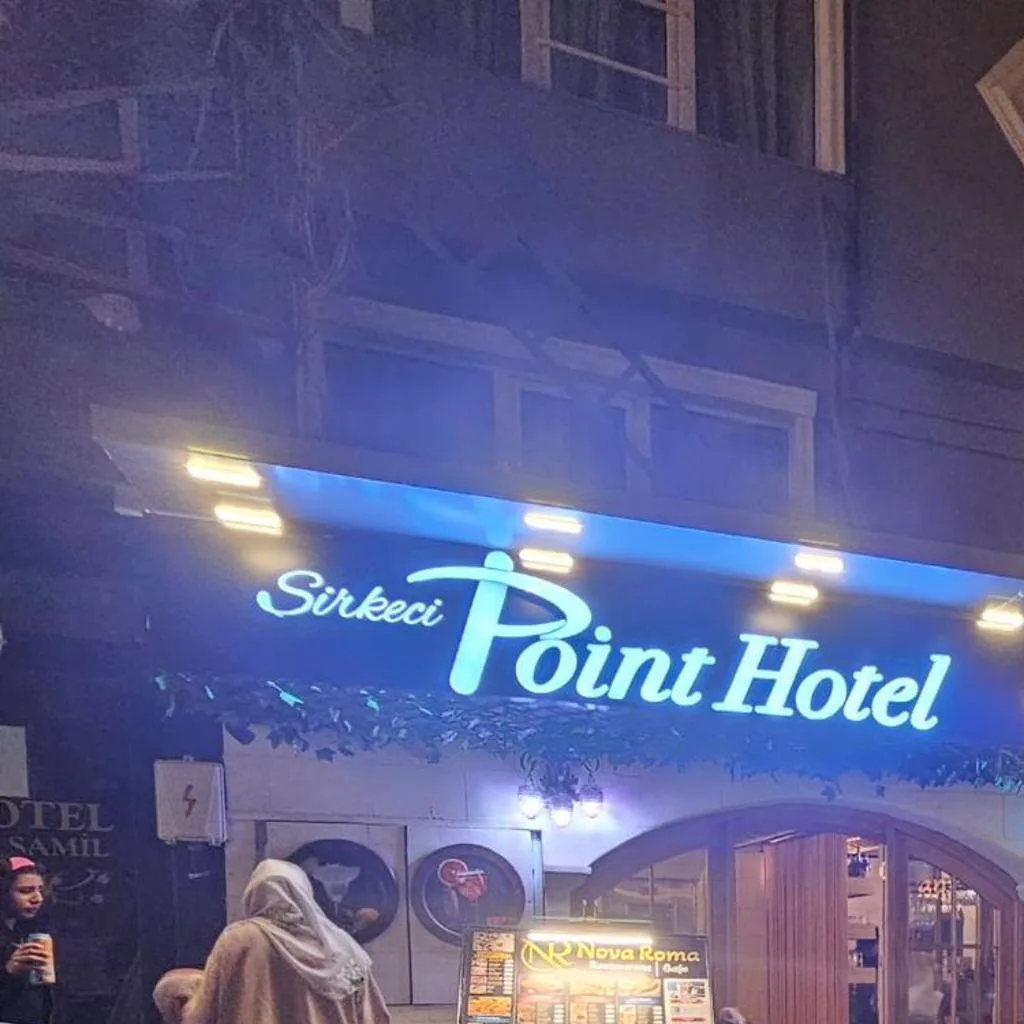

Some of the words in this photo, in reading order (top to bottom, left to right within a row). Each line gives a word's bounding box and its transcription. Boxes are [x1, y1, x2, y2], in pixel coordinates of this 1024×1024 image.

[257, 569, 444, 627] Sirkeci
[406, 550, 716, 706] Point
[711, 633, 952, 731] Hotel
[576, 943, 634, 961] Nova
[639, 945, 701, 962] Roma
